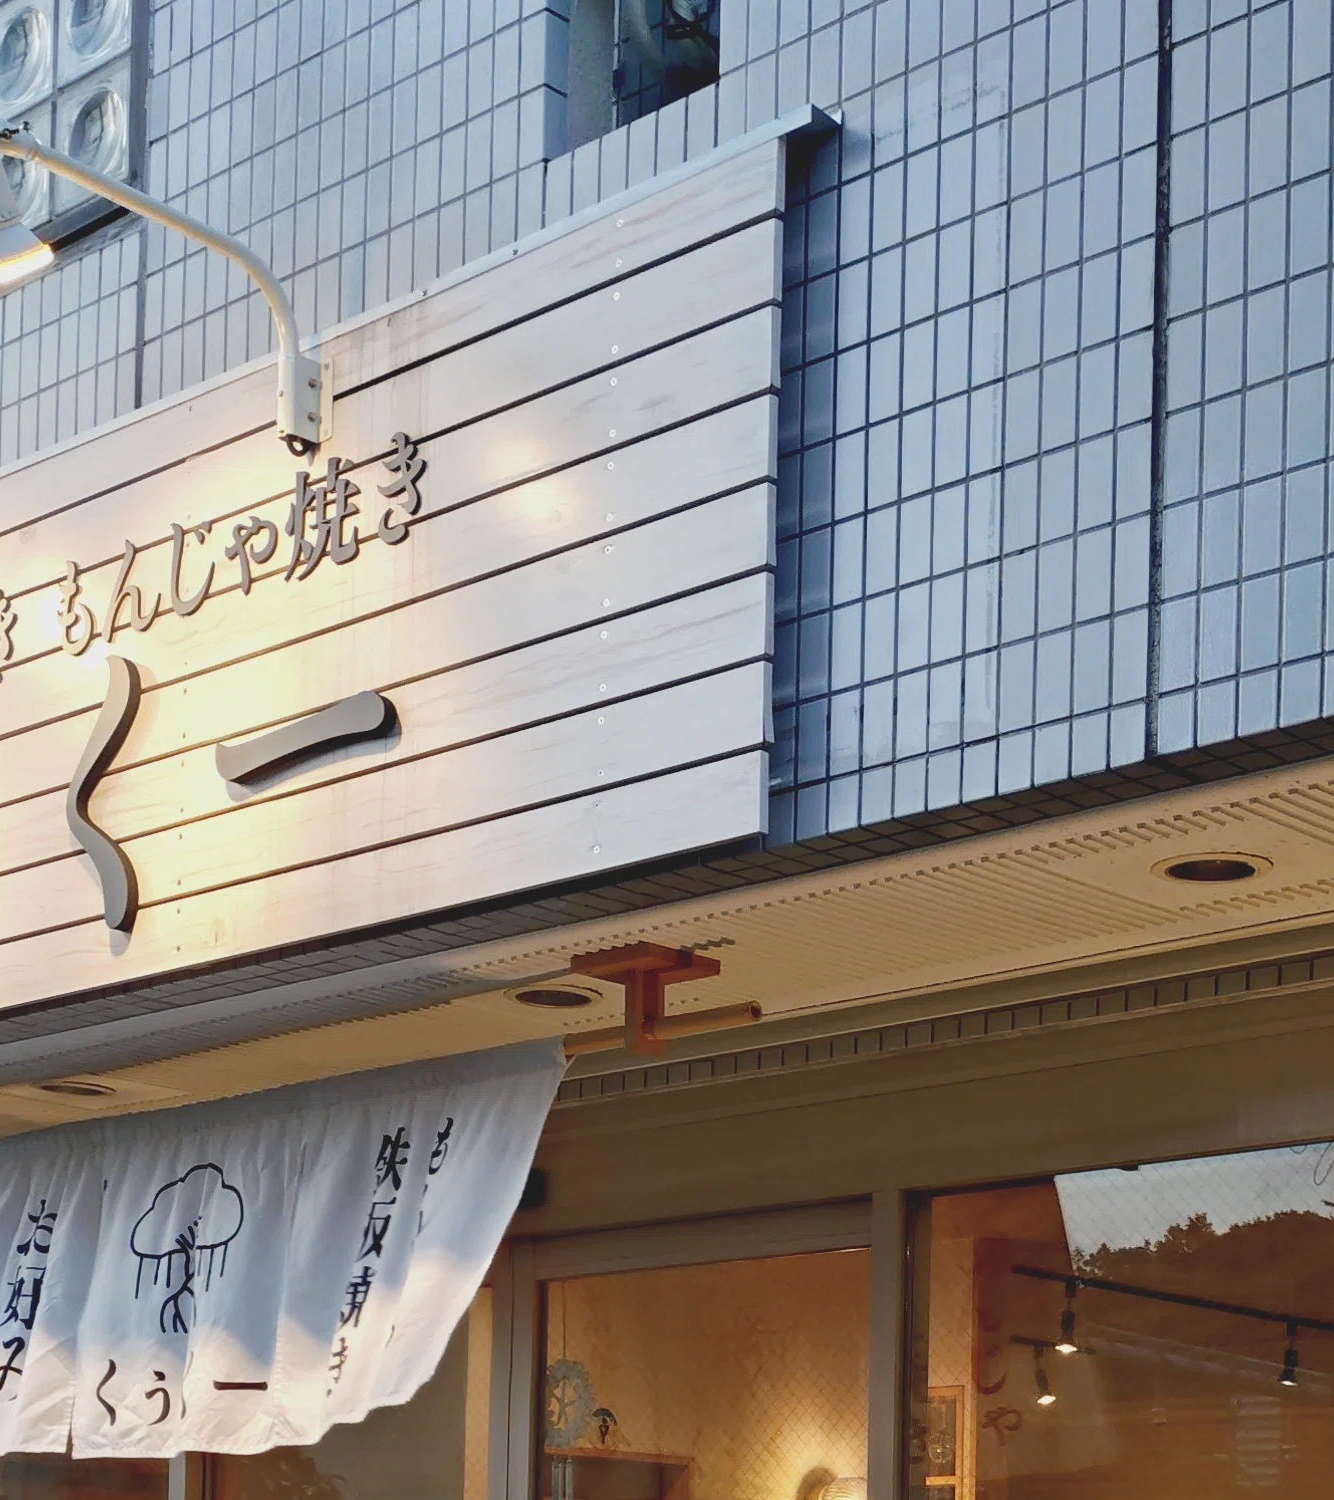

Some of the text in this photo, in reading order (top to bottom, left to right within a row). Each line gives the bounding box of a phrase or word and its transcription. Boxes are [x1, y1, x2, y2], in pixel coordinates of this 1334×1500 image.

[57, 432, 427, 655] もんじゃ焼き
